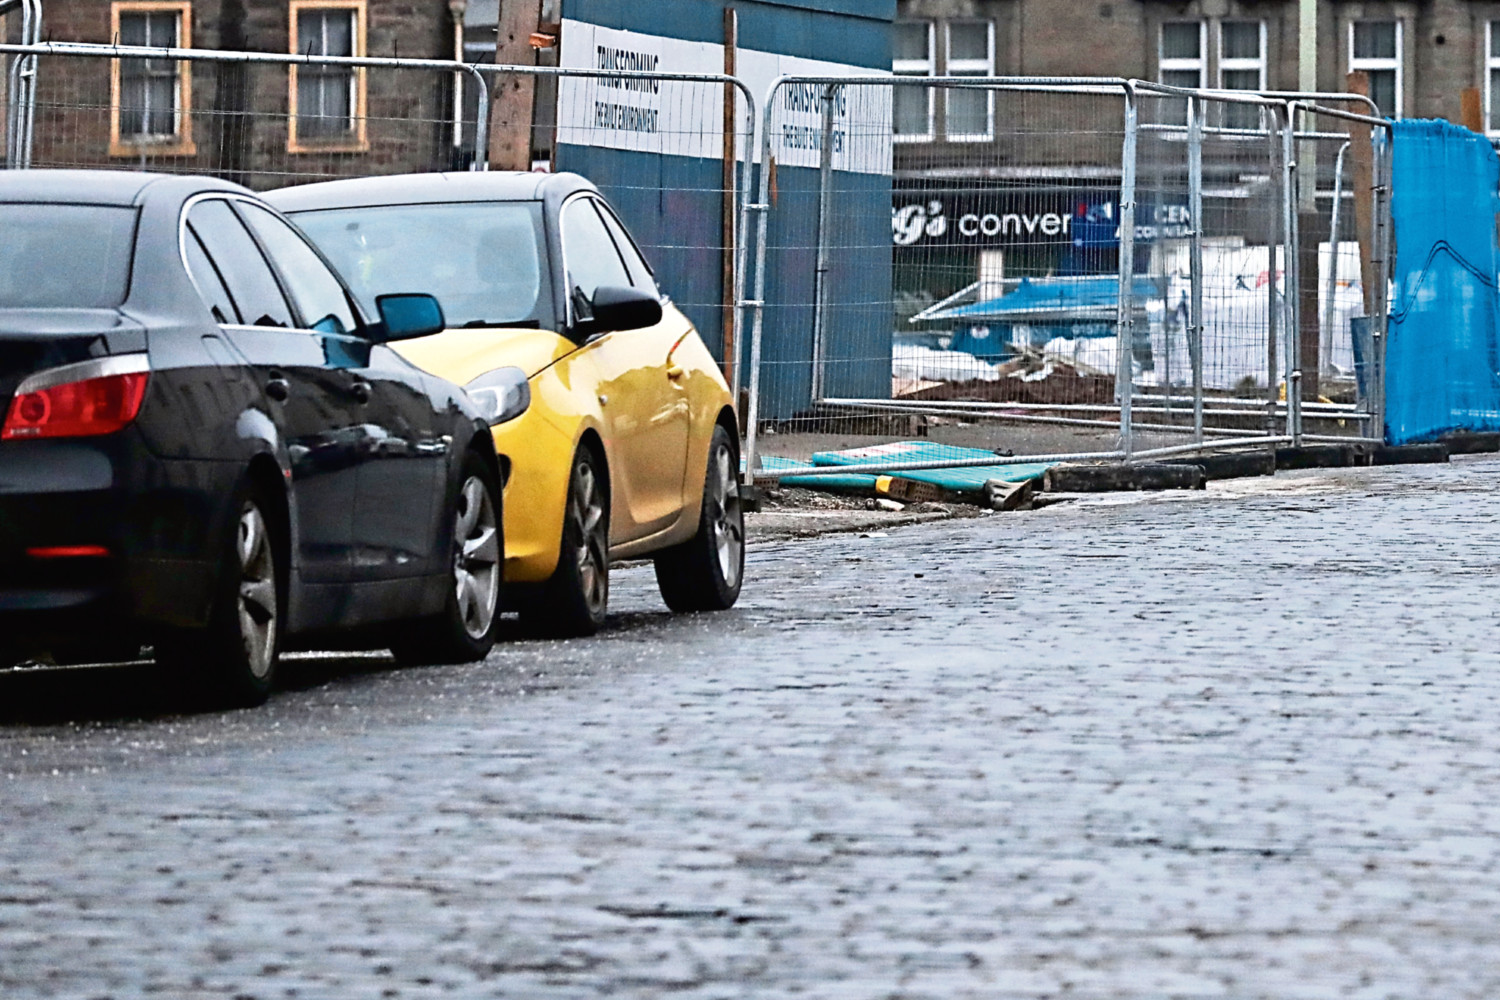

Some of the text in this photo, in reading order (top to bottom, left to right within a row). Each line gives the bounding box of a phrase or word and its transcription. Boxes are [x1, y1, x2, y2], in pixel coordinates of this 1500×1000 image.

[597, 45, 659, 95] TRANSFORMING
[783, 73, 846, 118] TRANSFONG
[595, 101, 659, 134] THE BUILT ENVIRONMENT
[783, 124, 794, 149] THE
